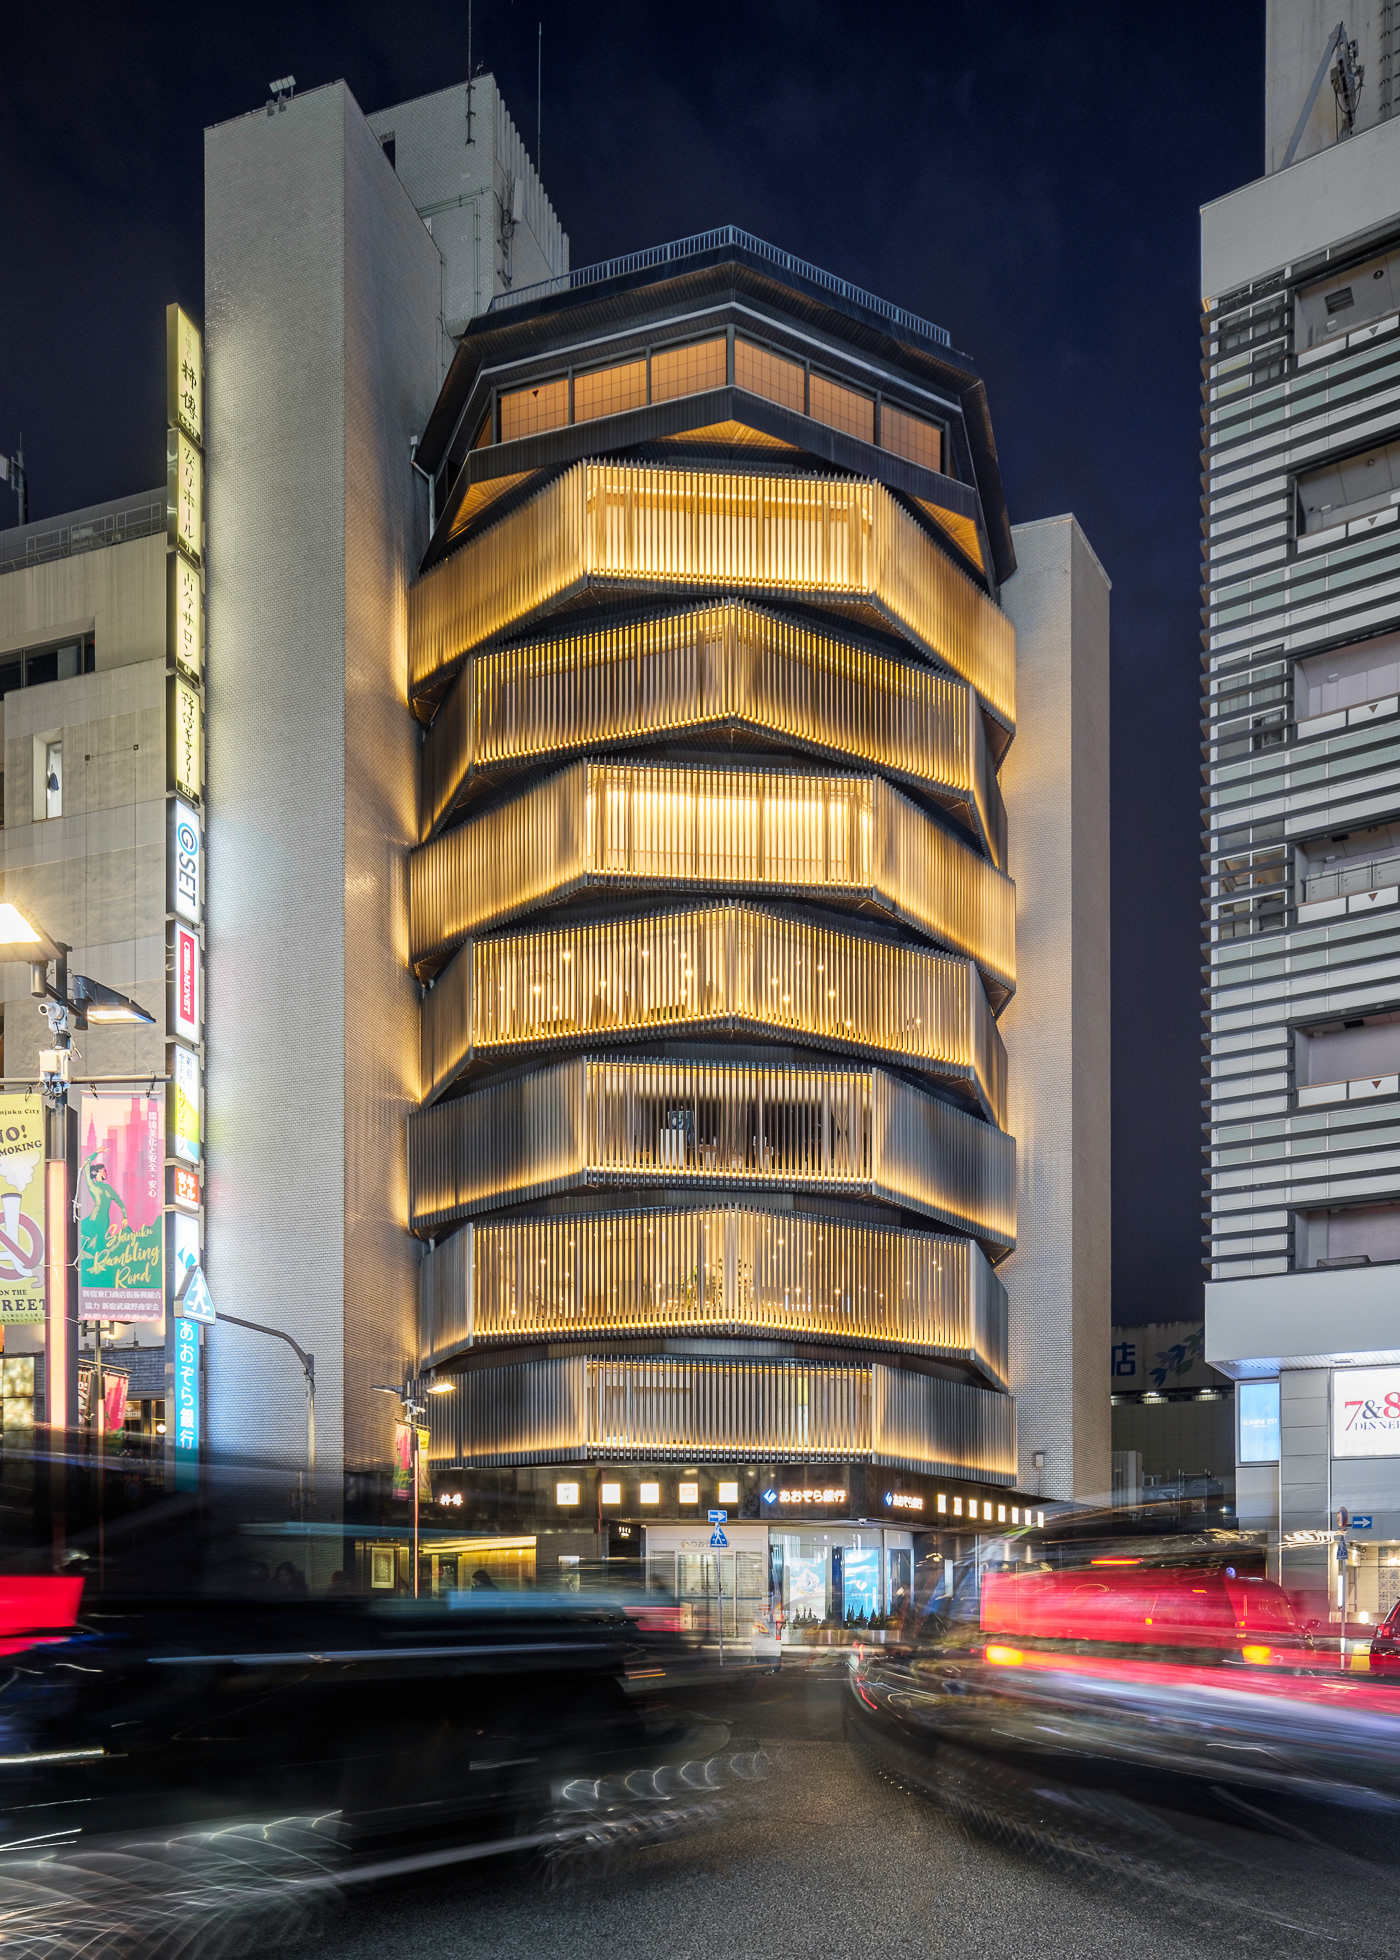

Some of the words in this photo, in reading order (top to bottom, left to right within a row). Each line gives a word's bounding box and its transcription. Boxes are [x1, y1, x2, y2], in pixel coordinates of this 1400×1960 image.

[184, 448, 195, 539] 安与ホール
[183, 572, 194, 657] 古今サロン
[179, 1184, 195, 1200] ビル
[94, 1241, 160, 1272] Rambling
[115, 1262, 151, 1290] Road
[1111, 1341, 1136, 1377] 店
[179, 1321, 195, 1449] あおぞら銀行
[780, 1489, 846, 1503] あおぞら銀行
